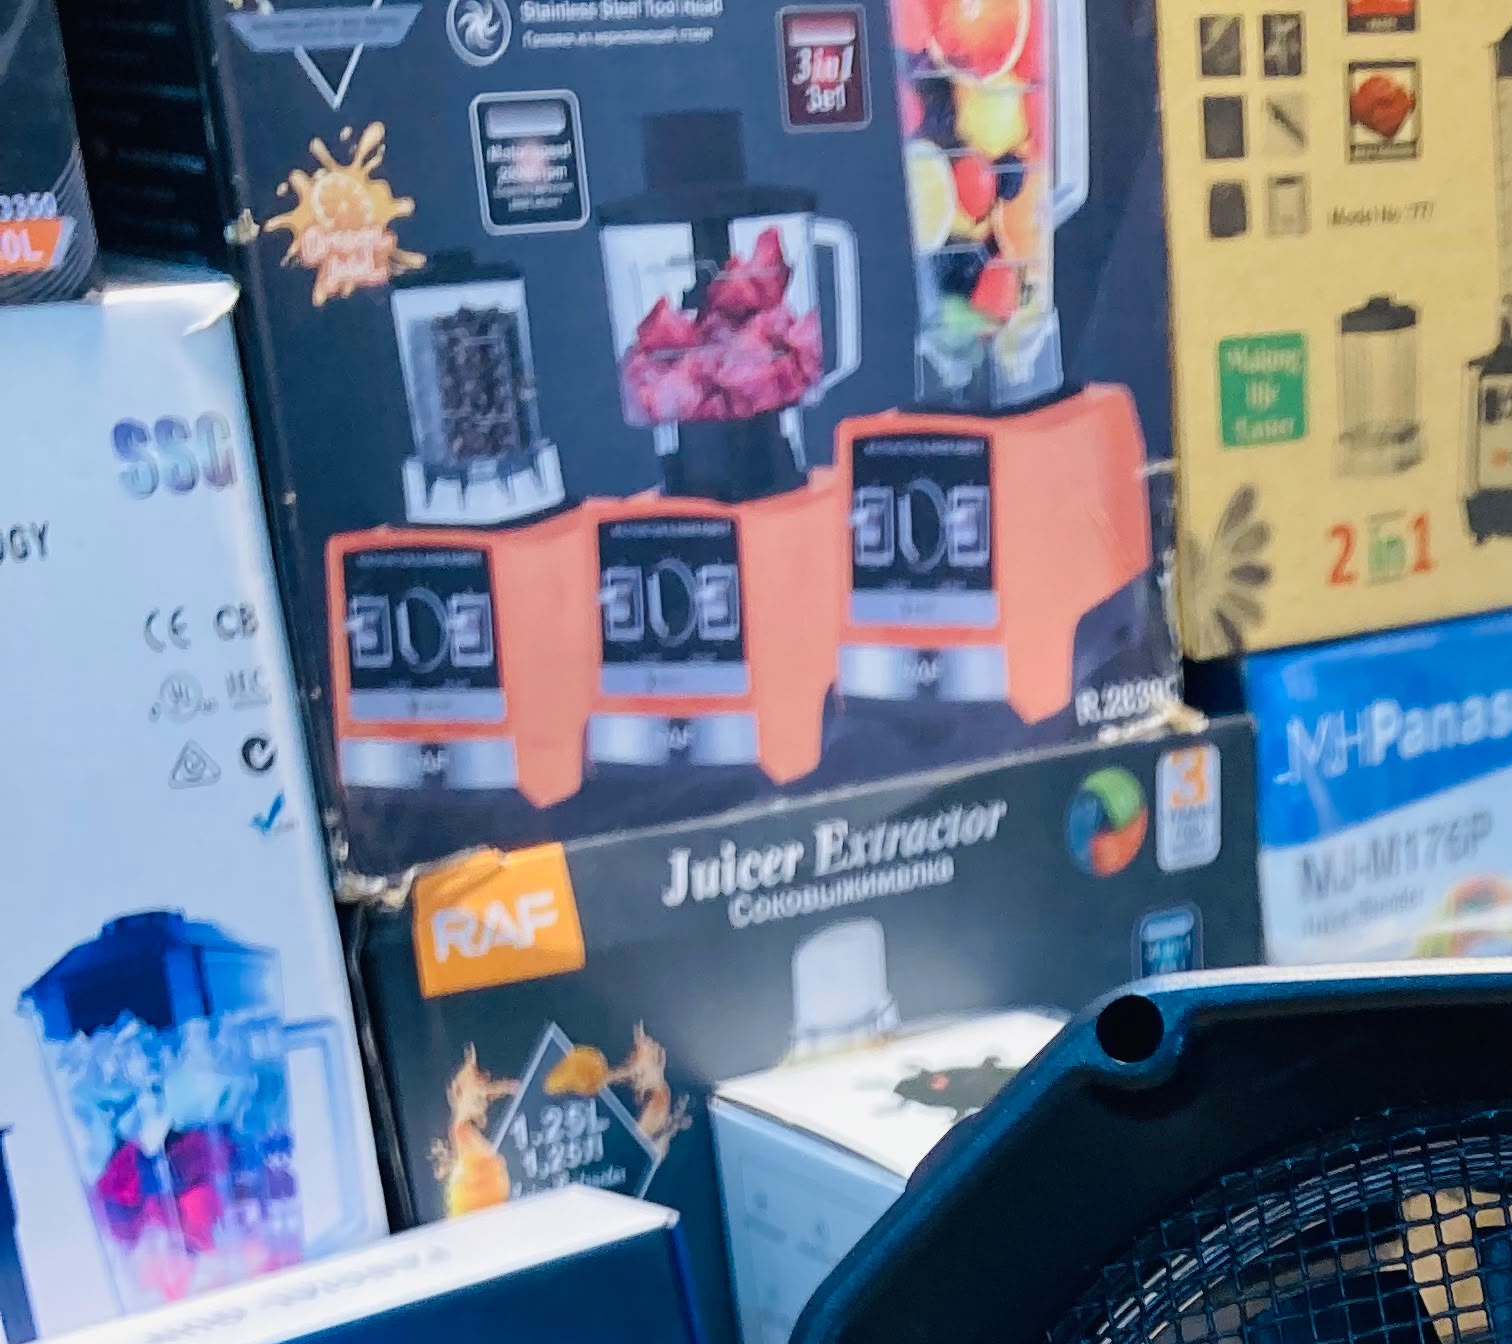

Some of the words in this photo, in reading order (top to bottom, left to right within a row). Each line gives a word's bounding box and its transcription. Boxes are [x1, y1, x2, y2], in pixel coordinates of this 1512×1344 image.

[0, 521, 49, 564] GY
[661, 838, 805, 908] Juicer
[813, 798, 1009, 878] Extractor
[433, 888, 560, 966] RAF
